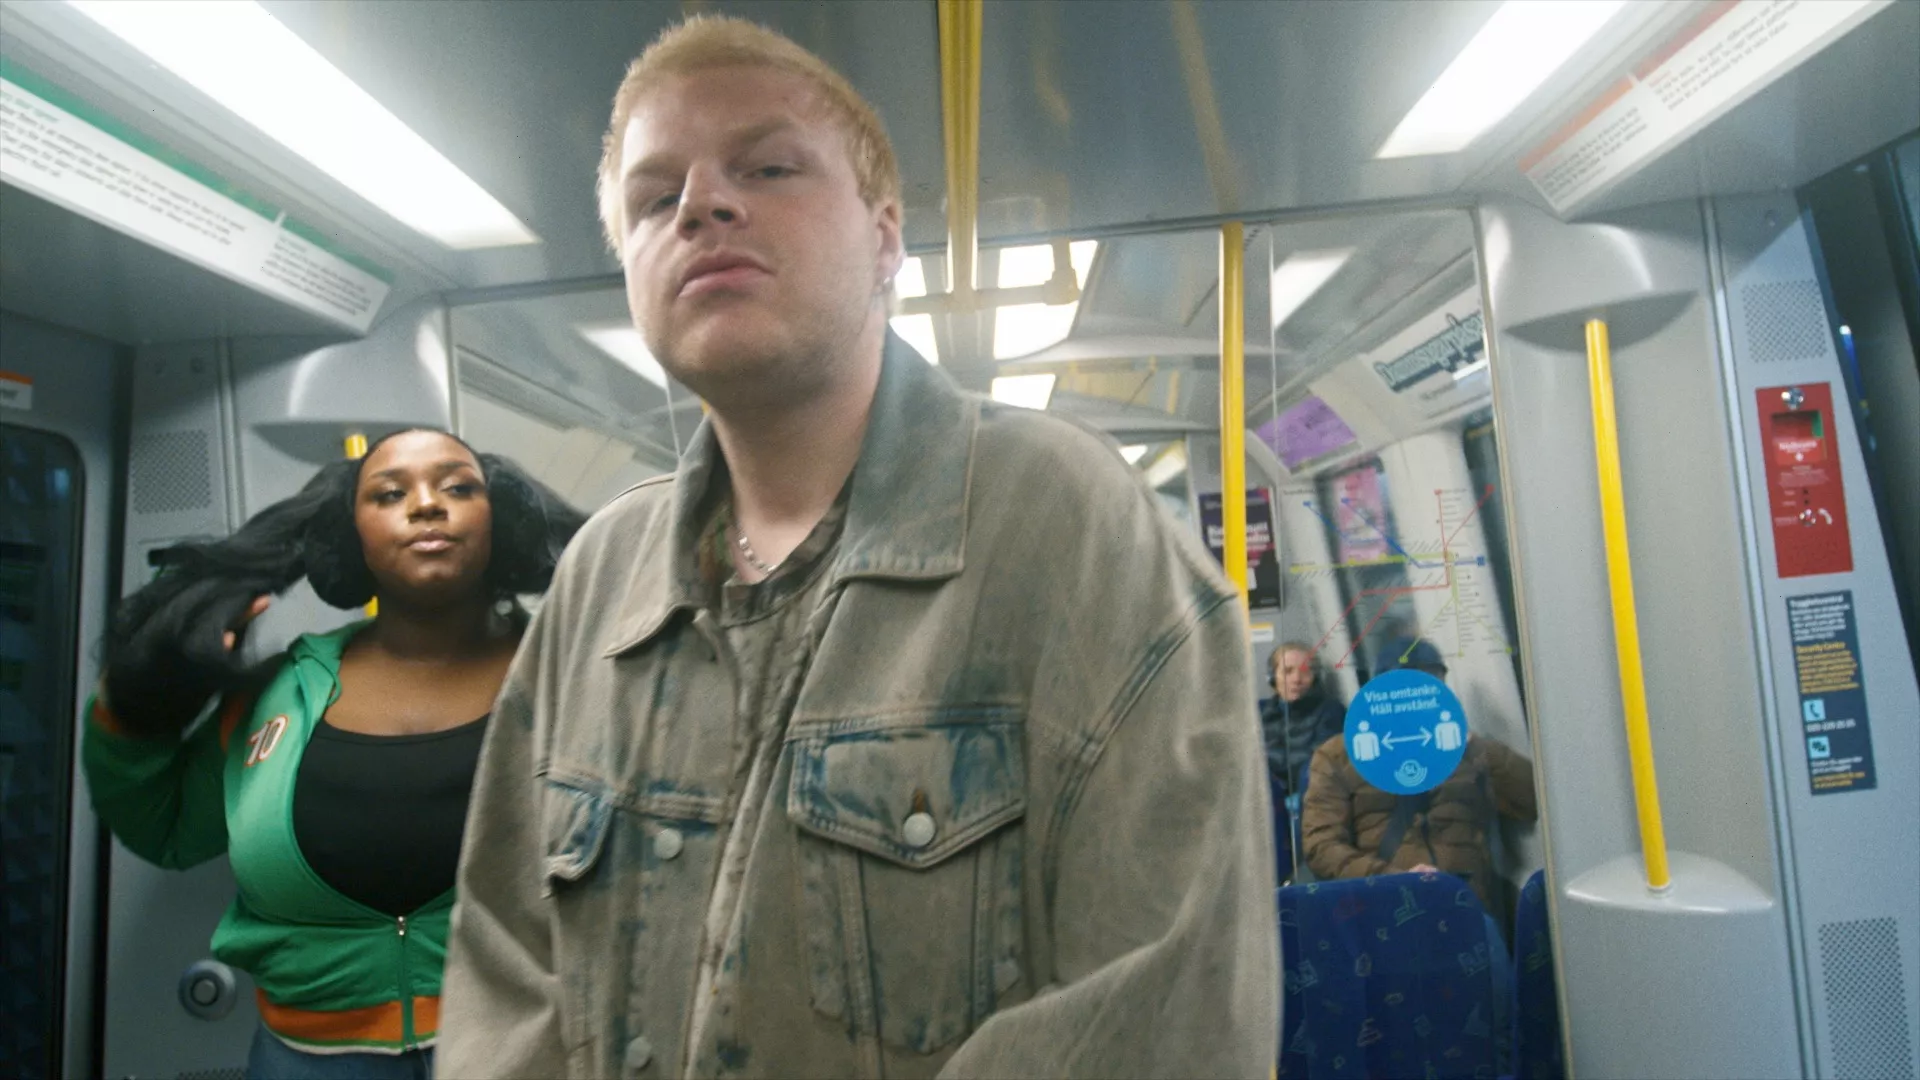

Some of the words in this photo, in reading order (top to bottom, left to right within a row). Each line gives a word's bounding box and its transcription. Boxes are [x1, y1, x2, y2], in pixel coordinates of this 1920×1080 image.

[1364, 691, 1388, 702] Visa
[1390, 684, 1440, 699] omtanke.
[1370, 702, 1392, 716] Håll
[1394, 697, 1440, 713] avstånd.
